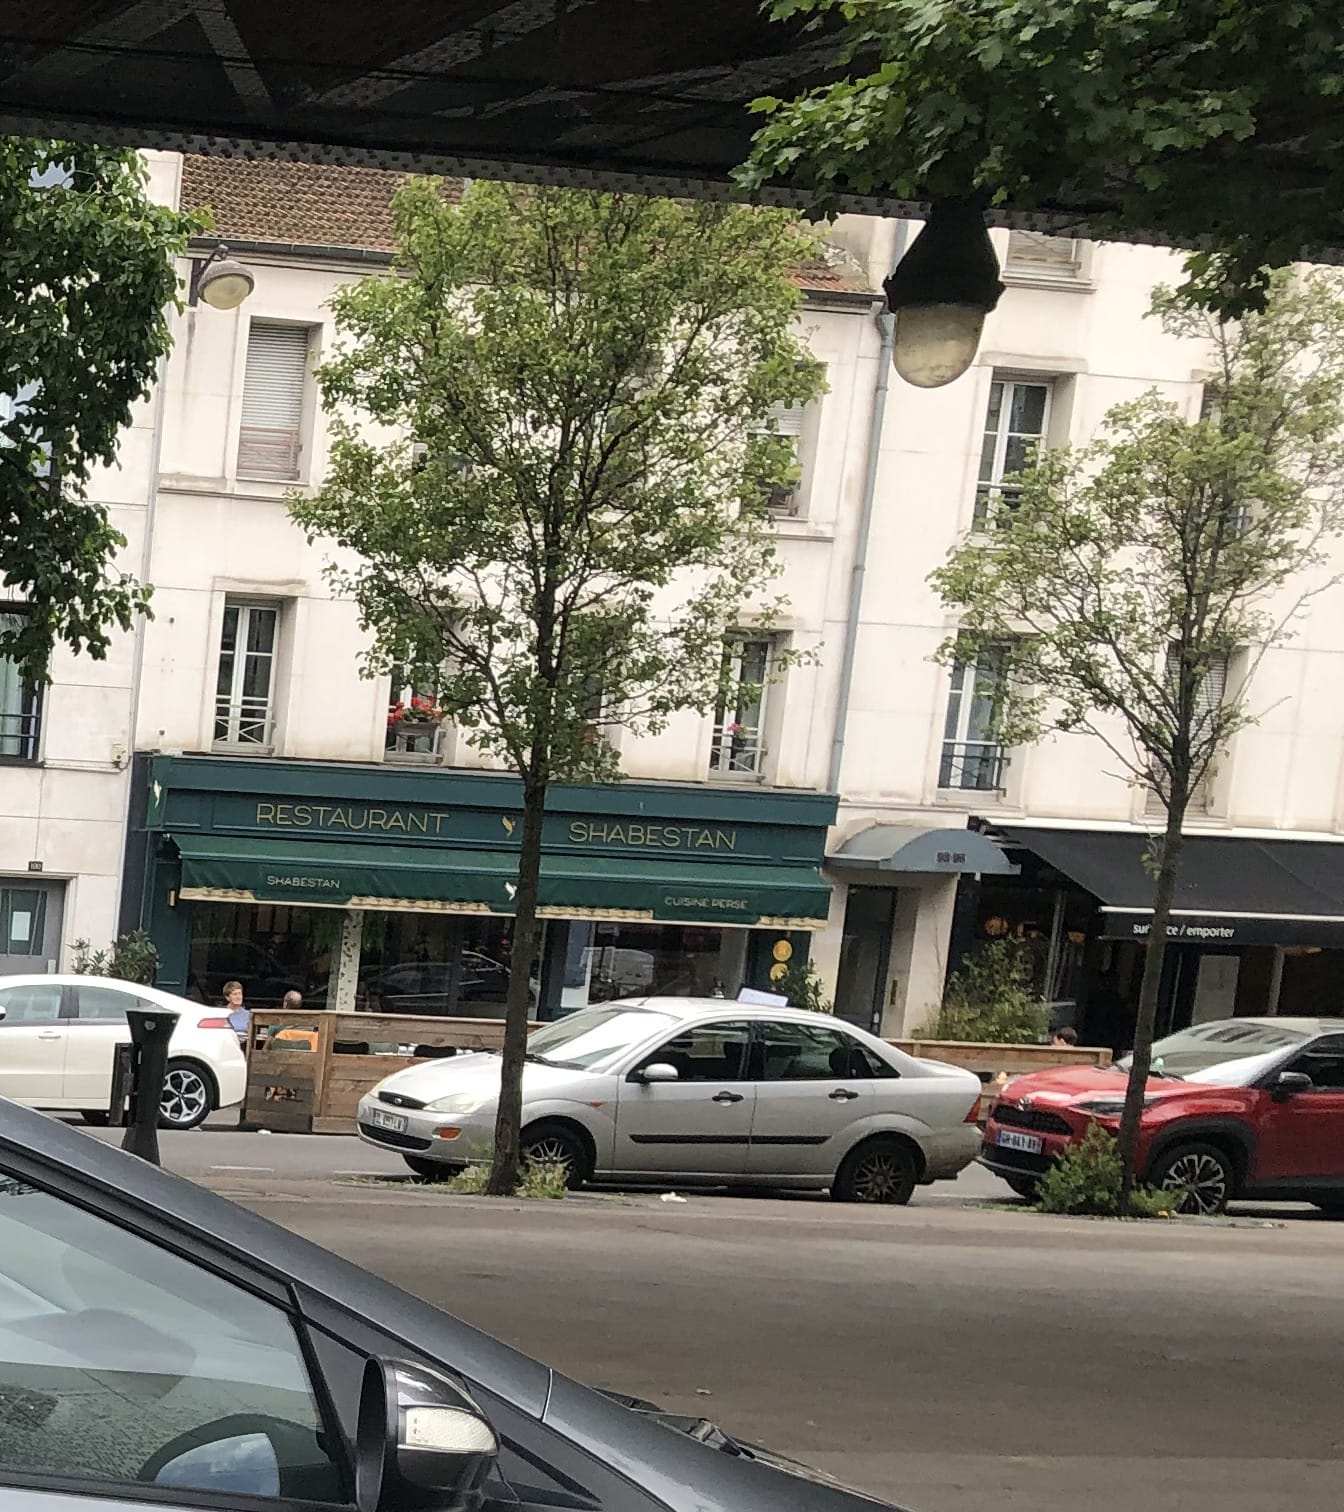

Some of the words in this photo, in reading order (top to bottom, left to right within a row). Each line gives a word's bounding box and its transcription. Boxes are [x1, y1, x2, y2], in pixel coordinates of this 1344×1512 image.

[256, 803, 450, 833] RESTAURANT
[568, 821, 737, 850] SHABESTAN
[267, 875, 340, 889] SHABESTAN
[664, 896, 709, 908] CUISINE
[711, 899, 748, 910] PERSE
[1186, 926, 1234, 938] emporter
